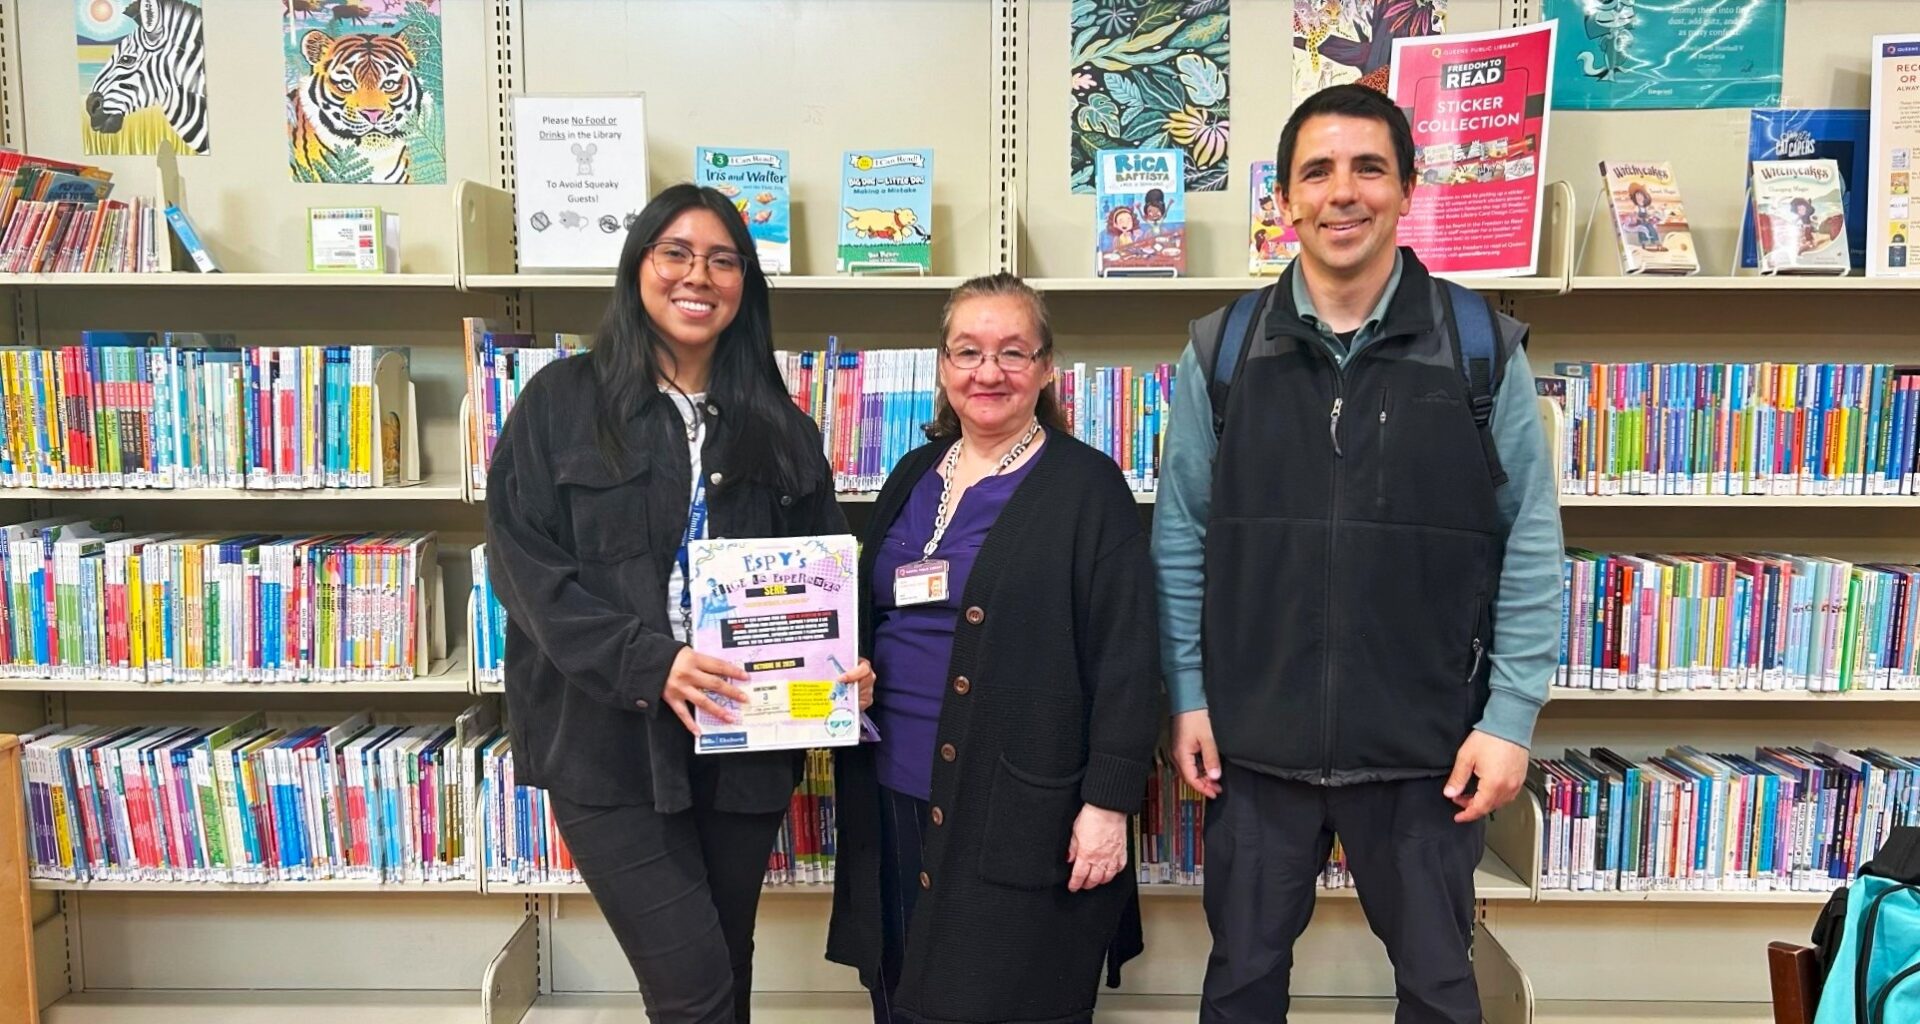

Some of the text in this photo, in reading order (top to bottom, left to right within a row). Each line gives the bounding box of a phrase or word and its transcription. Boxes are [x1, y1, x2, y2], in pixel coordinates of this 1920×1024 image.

[1494, 42, 1520, 51] LIBRARY
[1447, 58, 1502, 73] FREEDOM TO
[1447, 67, 1502, 89] READ
[1900, 75, 1917, 83] OR
[1437, 96, 1504, 114] STICKER
[543, 116, 617, 126] Please No Food or
[1417, 112, 1520, 134] COLLECTION
[539, 131, 622, 141] Drinks in the Library
[716, 155, 724, 165] 3
[706, 169, 788, 184] Iris and Walter
[1116, 172, 1170, 182] BAPTISTA
[1613, 164, 1669, 180] Witchycakes
[1761, 165, 1829, 180] Witchycakes
[547, 180, 620, 190] To Avoid Squeaky
[568, 195, 599, 203] Guests!
[764, 585, 788, 596] SERIE
